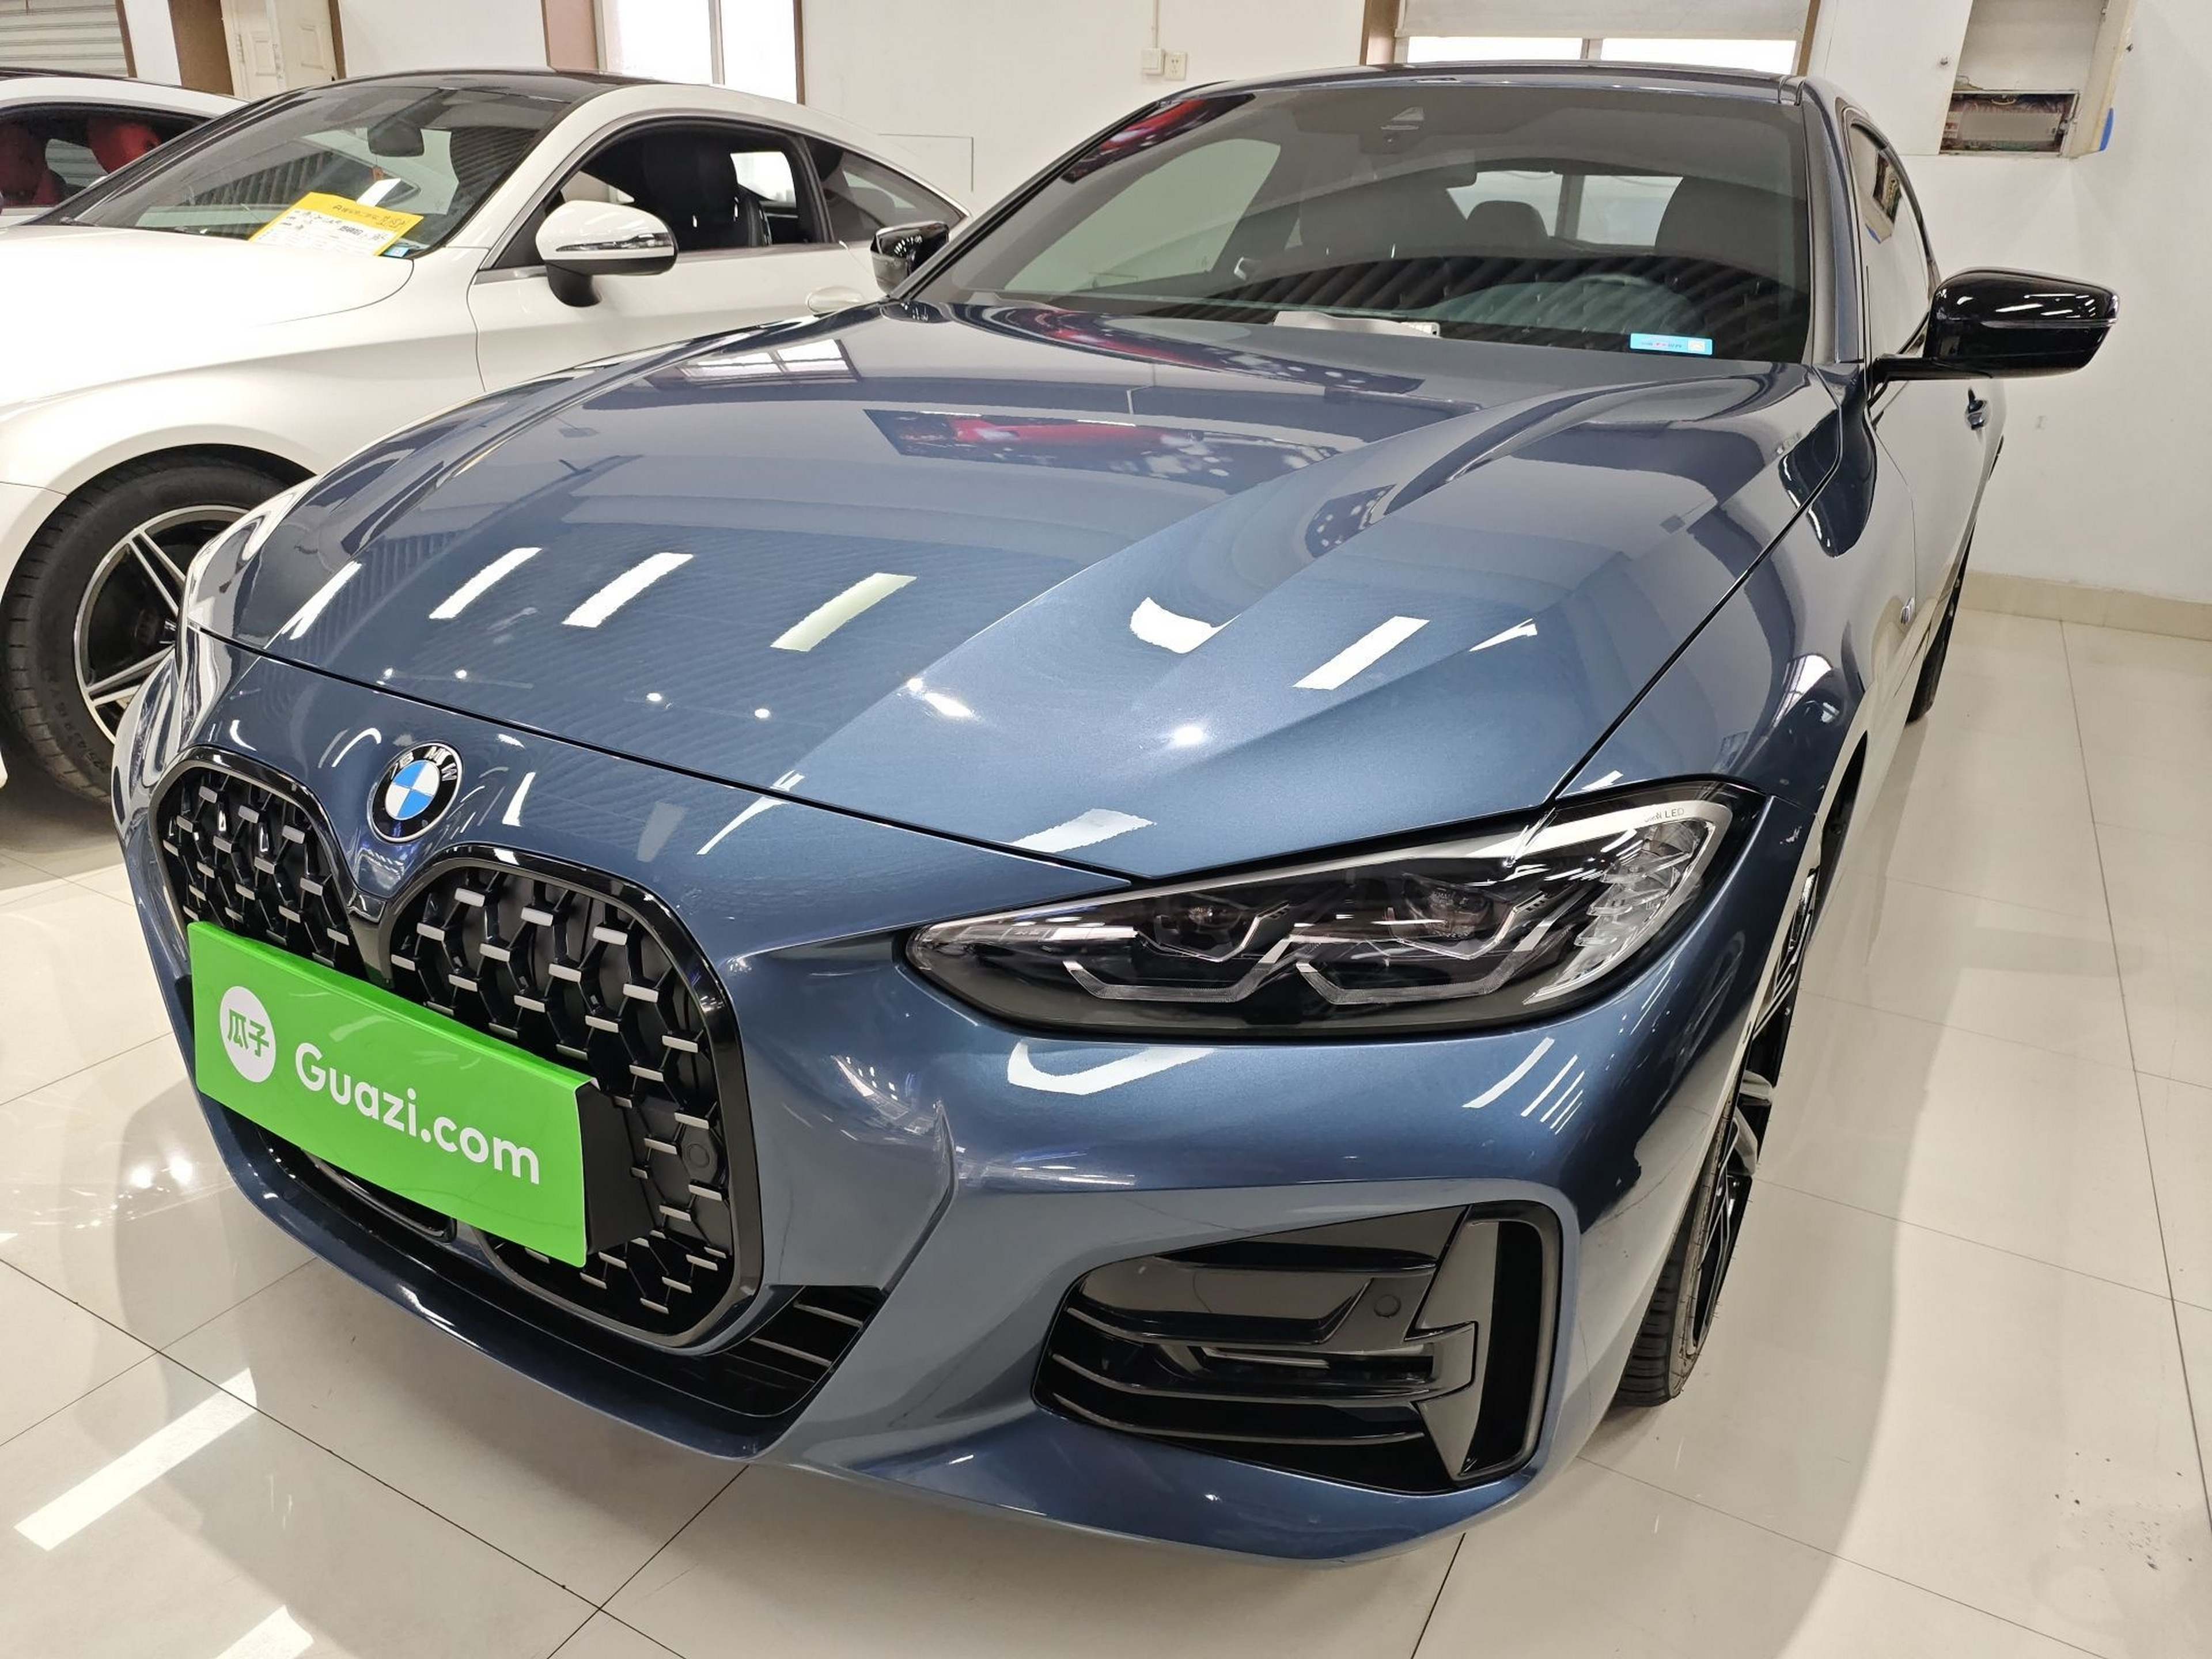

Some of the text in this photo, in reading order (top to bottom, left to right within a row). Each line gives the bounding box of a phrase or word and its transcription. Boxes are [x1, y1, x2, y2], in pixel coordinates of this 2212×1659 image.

[399, 746, 457, 781] BMW
[1665, 808, 1684, 818] LED
[228, 1009, 269, 1057] 瓜子
[296, 1043, 539, 1184] Guazi.com
